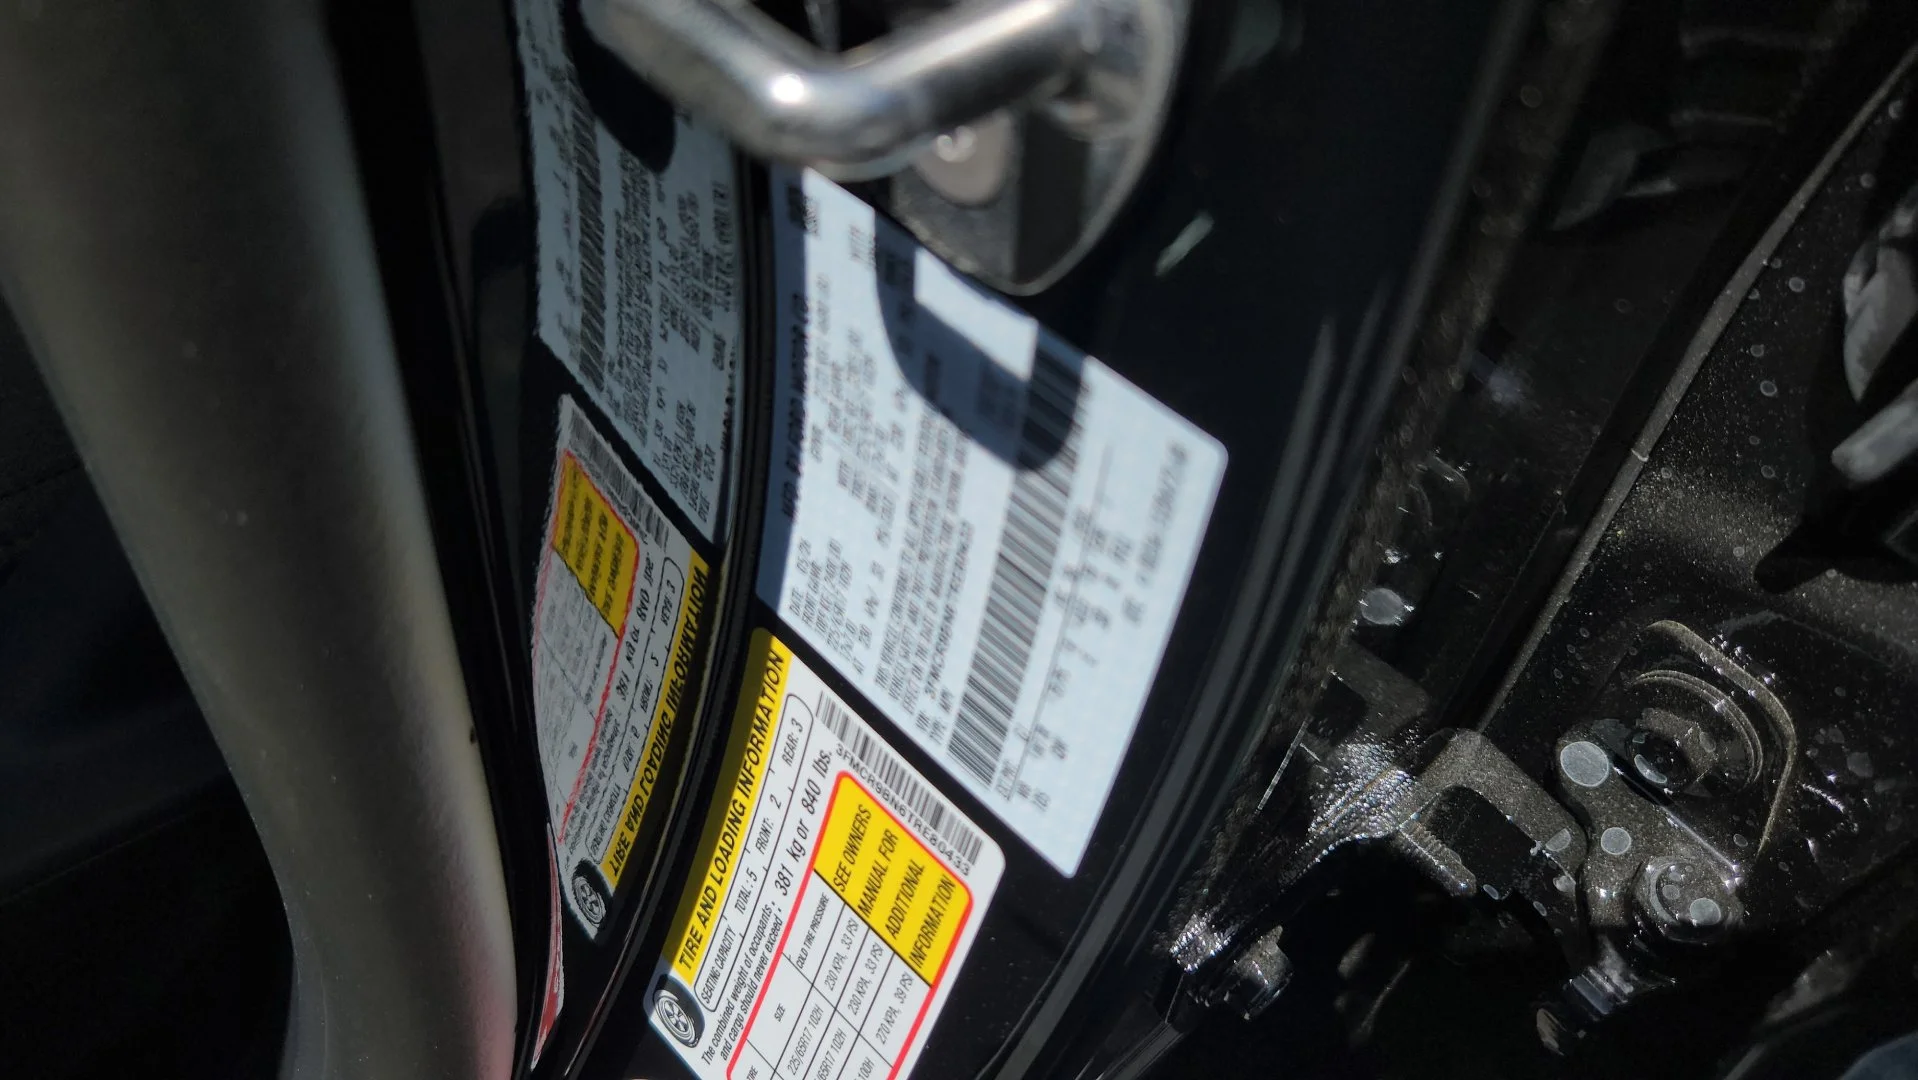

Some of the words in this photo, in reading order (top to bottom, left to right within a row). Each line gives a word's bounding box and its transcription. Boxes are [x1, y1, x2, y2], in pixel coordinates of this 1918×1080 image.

[802, 592, 815, 626] FRONT
[852, 657, 864, 675] AT
[858, 625, 872, 648] 230
[881, 625, 898, 665] VEHICLE
[875, 666, 888, 688] THIS
[888, 662, 906, 700] VEHICLE
[902, 679, 918, 715] EFFECT
[812, 750, 832, 778] lbs.
[679, 925, 703, 969] TIRE
[697, 885, 717, 929] AND
[710, 799, 746, 886] LOADING
[736, 644, 783, 799] INFORMATION
[801, 779, 821, 815] 840
[797, 818, 809, 840] or
[701, 966, 721, 1004] SEATING
[714, 925, 736, 970] CAPACITY
[746, 868, 757, 882] 5
[755, 818, 773, 855] FRONT:
[770, 794, 781, 809] 2
[782, 733, 798, 766] REAR:
[791, 718, 803, 733] 3
[786, 838, 806, 862] kg
[833, 861, 851, 892] SEE
[843, 804, 871, 865] OWNERS
[775, 864, 793, 896] 381
[857, 860, 888, 918] MANUAL
[878, 829, 898, 861] FOR
[885, 860, 924, 940] ADDITIONAL
[796, 948, 808, 969] COLD
[803, 930, 815, 949] TIRE
[810, 893, 829, 933] PRESSURE
[846, 918, 859, 937] PSI
[909, 875, 955, 968] INFORMATION
[841, 933, 852, 950] 33
[870, 942, 883, 961] PSI
[824, 970, 838, 991] 230
[832, 952, 846, 974] KPA,
[865, 958, 877, 974] 33
[855, 976, 871, 998] KPA,
[701, 1046, 715, 1065] The
[712, 998, 735, 1047] combined
[731, 966, 751, 1002] weight
[744, 952, 753, 969] of
[720, 1038, 732, 1061] and
[729, 1013, 744, 1042] cargo
[740, 978, 758, 1014] should
[754, 951, 769, 982] never
[774, 1003, 785, 1022] SIZE
[847, 994, 861, 1016] 230
[875, 1023, 890, 1045] 270
[884, 1006, 899, 1027] KPA,
[894, 987, 906, 1004] 39
[900, 972, 913, 991] PSI
[787, 1026, 812, 1076] 225/65R17
[808, 1004, 824, 1029] 102H
[830, 1028, 846, 1053] 102H
